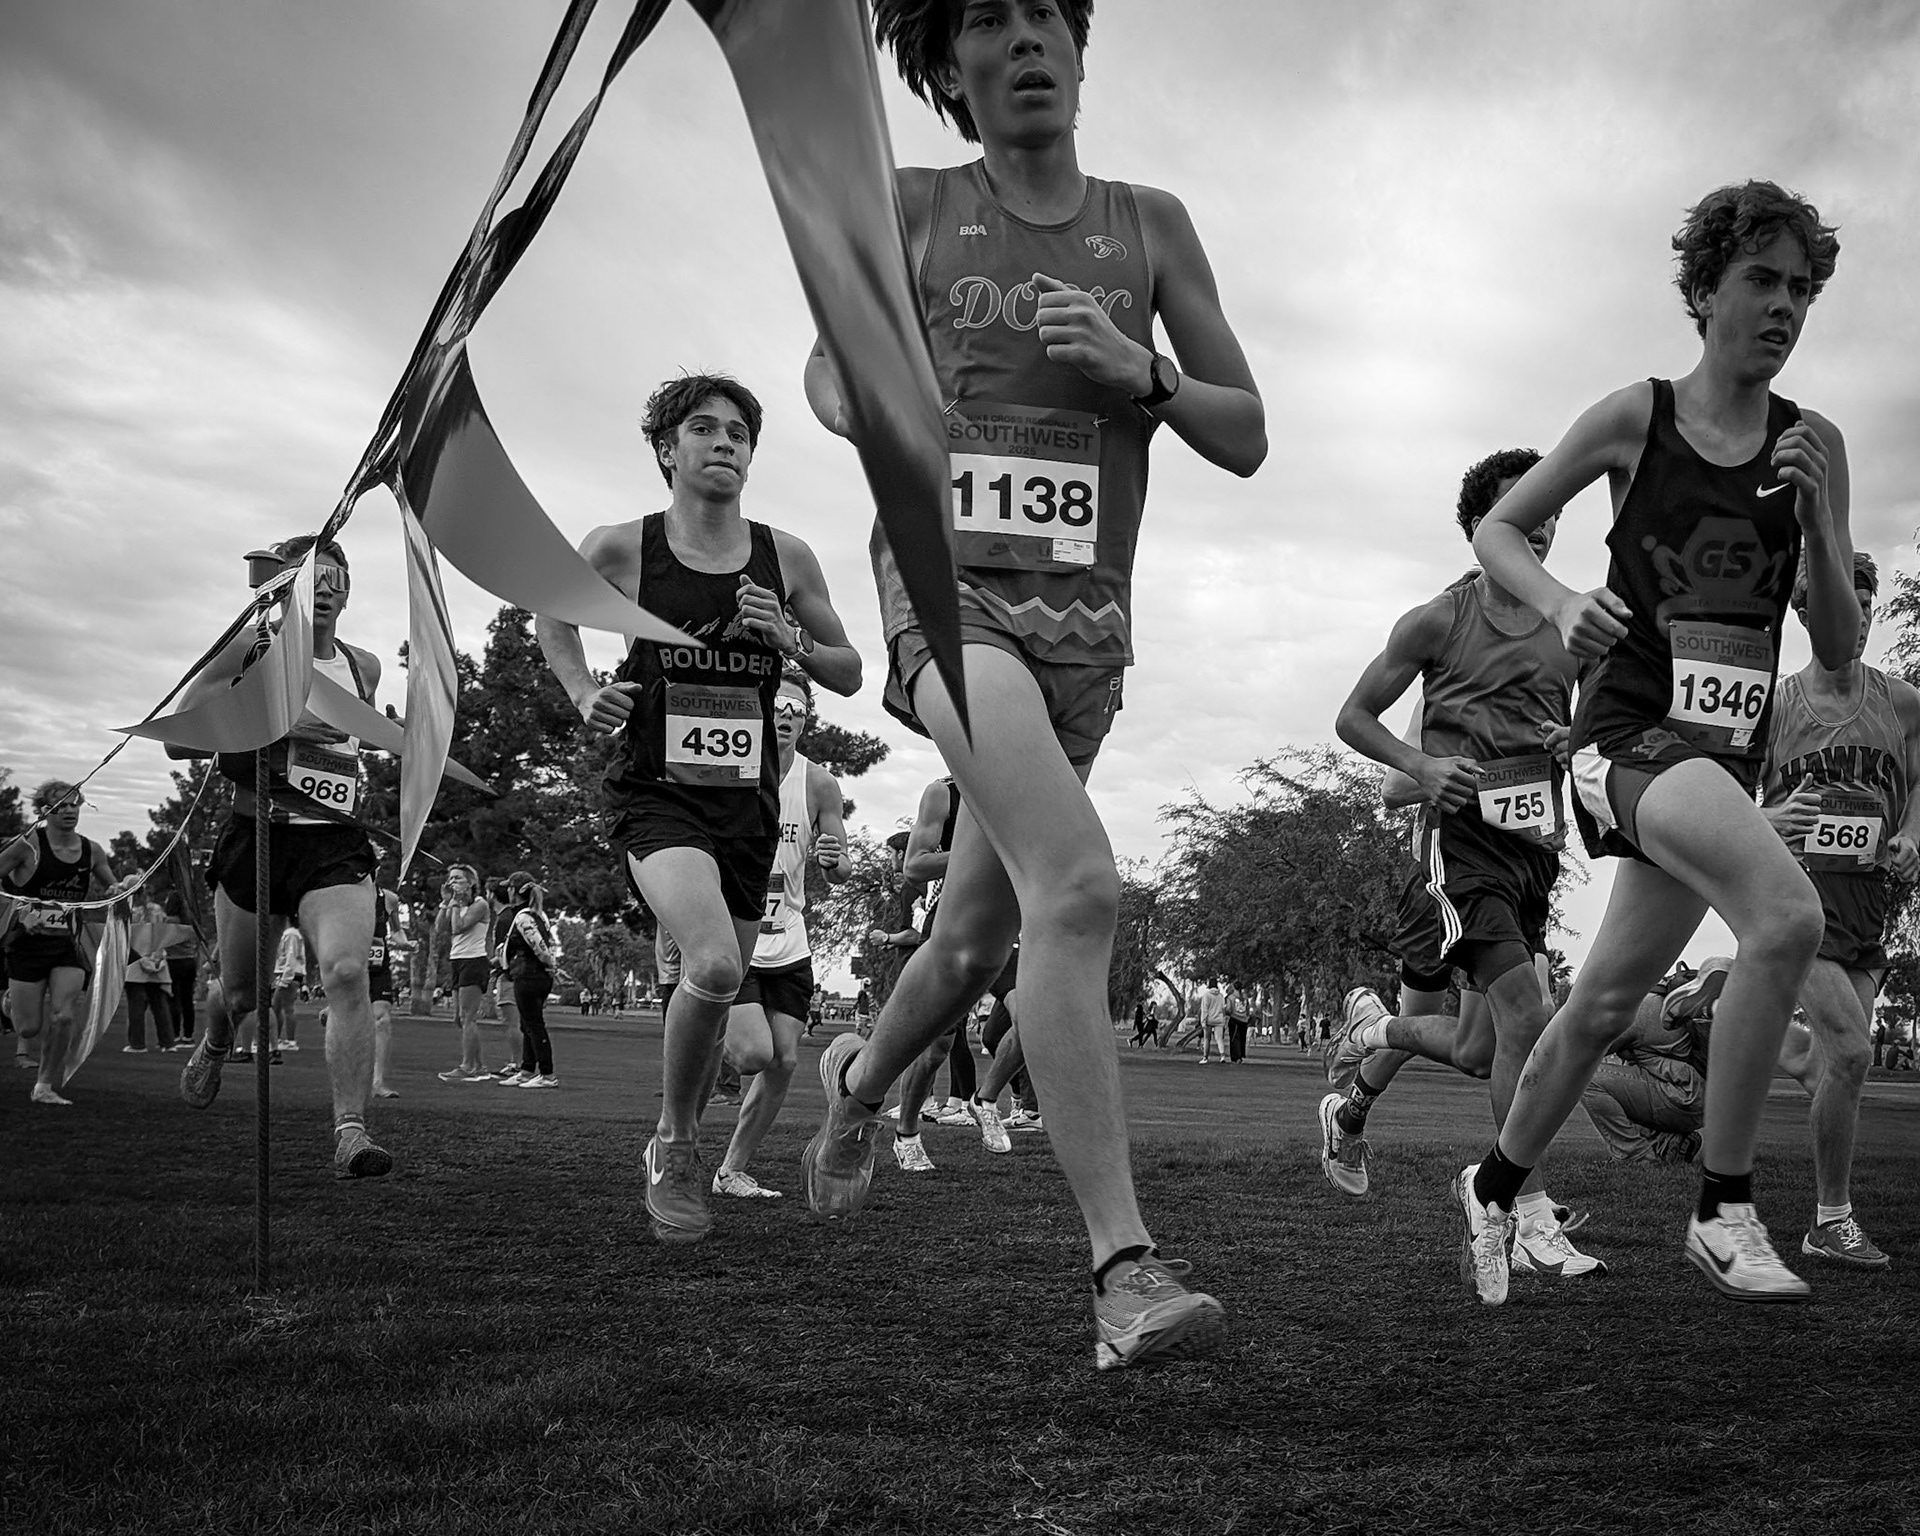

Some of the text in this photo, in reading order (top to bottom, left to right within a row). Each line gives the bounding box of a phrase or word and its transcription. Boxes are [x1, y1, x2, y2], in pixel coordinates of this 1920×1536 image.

[949, 422, 1094, 451] SOUTHWEST
[1008, 445, 1037, 456] 2025
[951, 470, 1093, 527] 1138
[1692, 540, 1758, 579] GS
[658, 647, 774, 676] BOULDER
[1676, 636, 1770, 660] SOUTHWEST
[670, 695, 758, 712] SOUTHWEST
[1679, 672, 1766, 720] 1346
[681, 727, 752, 758] 439
[298, 752, 356, 773] SOUTHWES
[1479, 764, 1548, 784] SOUTHWEST
[1779, 745, 1896, 797] HAWKS
[300, 776, 349, 804] 968
[1493, 791, 1545, 824] 755
[1820, 799, 1882, 811] OUTHWEST
[1817, 823, 1869, 848] 568
[46, 913, 67, 925] 44
